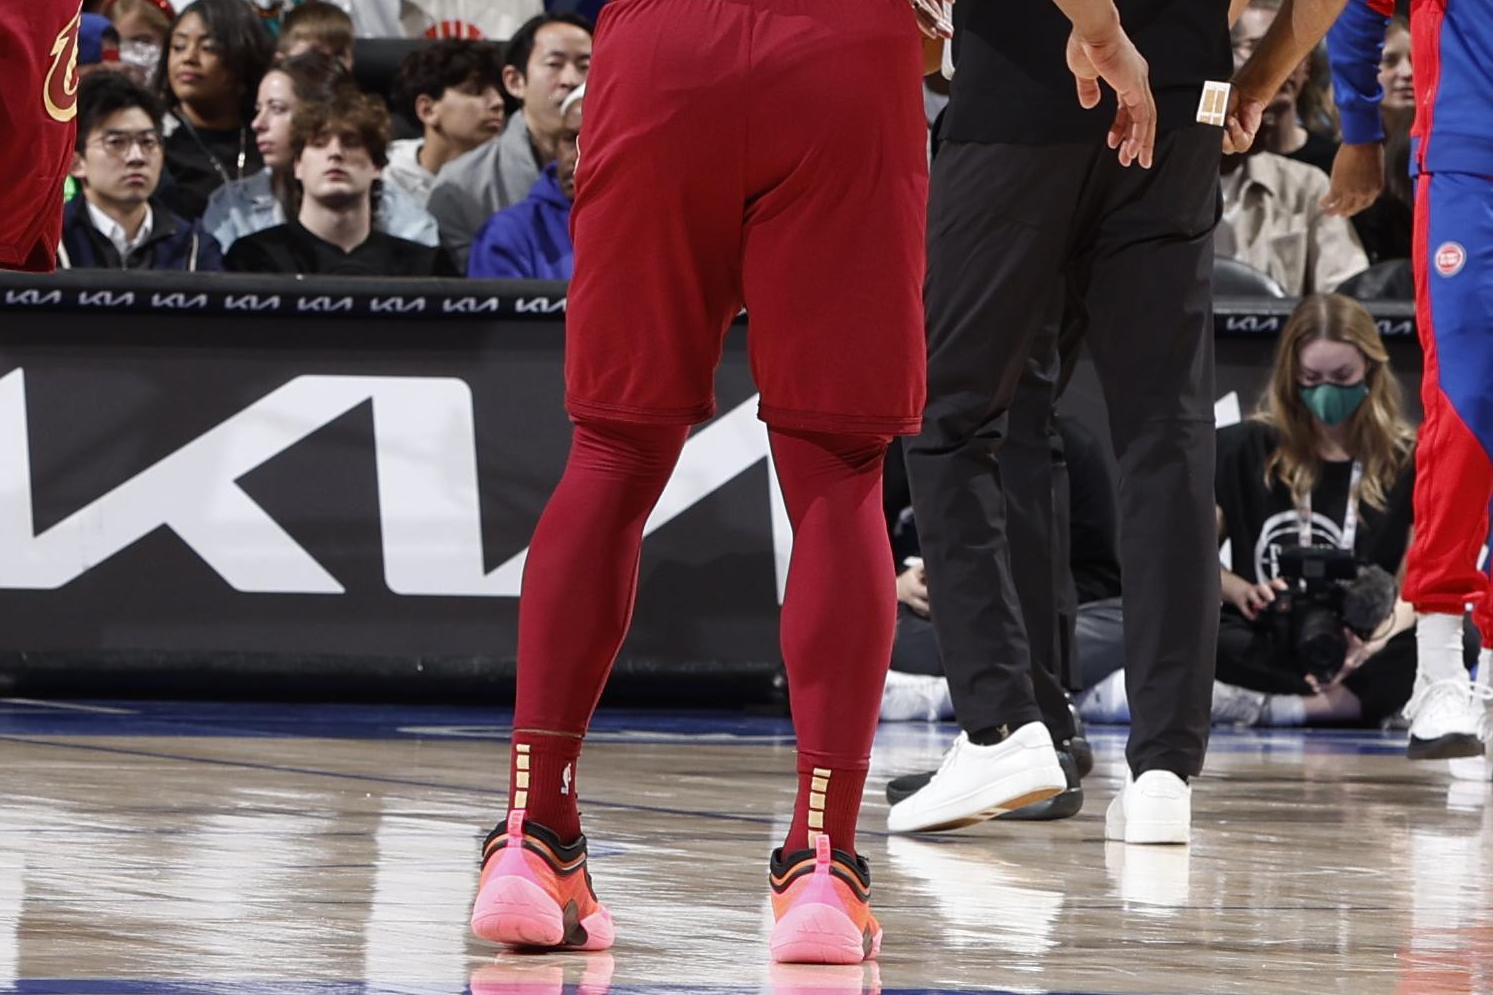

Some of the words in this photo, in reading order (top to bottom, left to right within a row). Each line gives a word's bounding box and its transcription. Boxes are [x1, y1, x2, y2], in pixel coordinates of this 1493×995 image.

[5, 289, 62, 304] KIA
[78, 291, 135, 305] KIA
[151, 293, 207, 308] KIA
[224, 295, 280, 309] KIA
[297, 296, 353, 311] KIA
[369, 296, 426, 312] KIA
[442, 297, 499, 312] KIA
[1225, 316, 1279, 331] KIA
